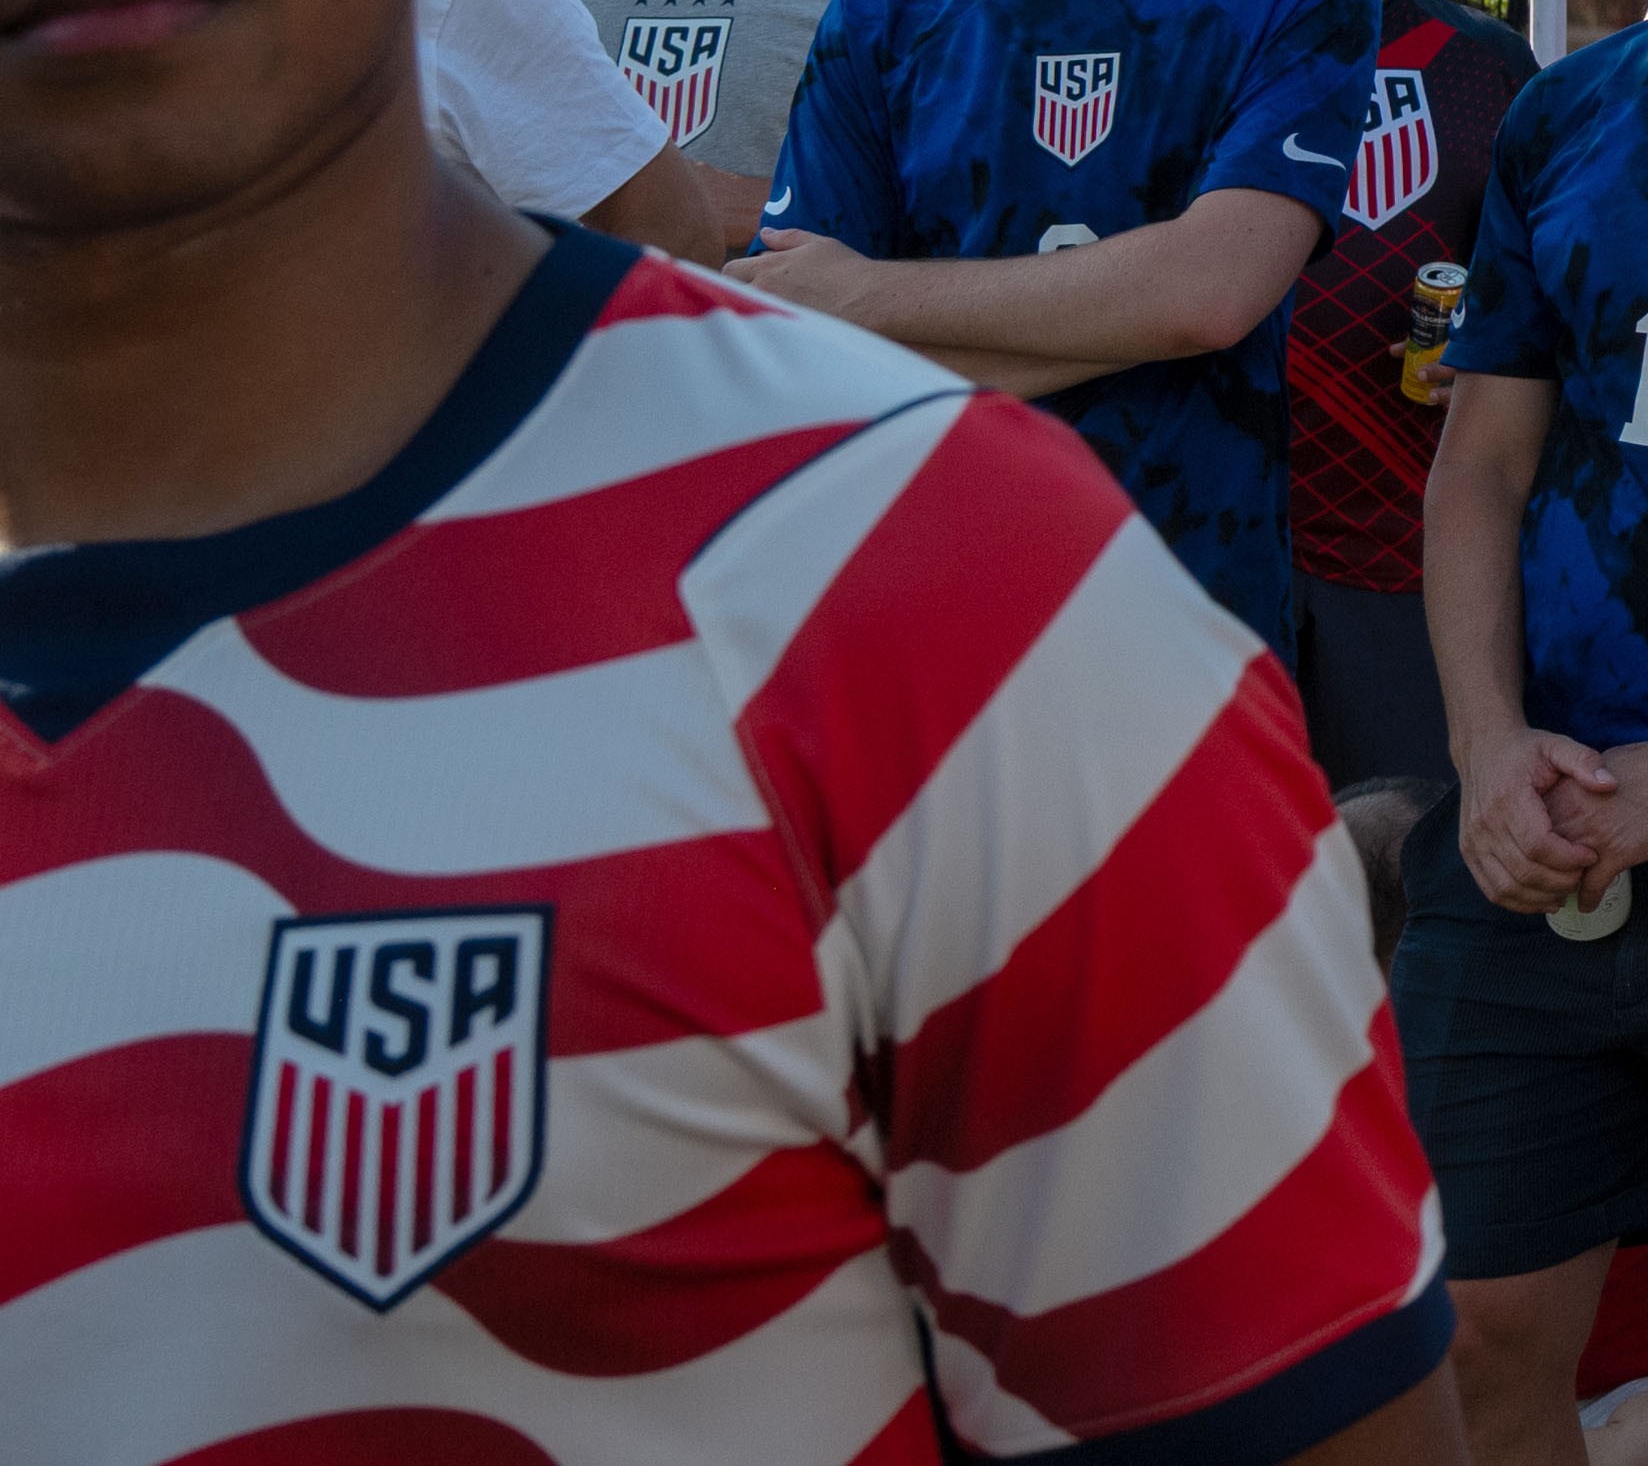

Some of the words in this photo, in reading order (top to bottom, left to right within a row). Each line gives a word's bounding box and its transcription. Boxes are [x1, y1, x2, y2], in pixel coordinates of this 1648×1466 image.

[628, 25, 728, 76] USA
[1040, 55, 1116, 101] USA
[287, 935, 520, 1078] USA
